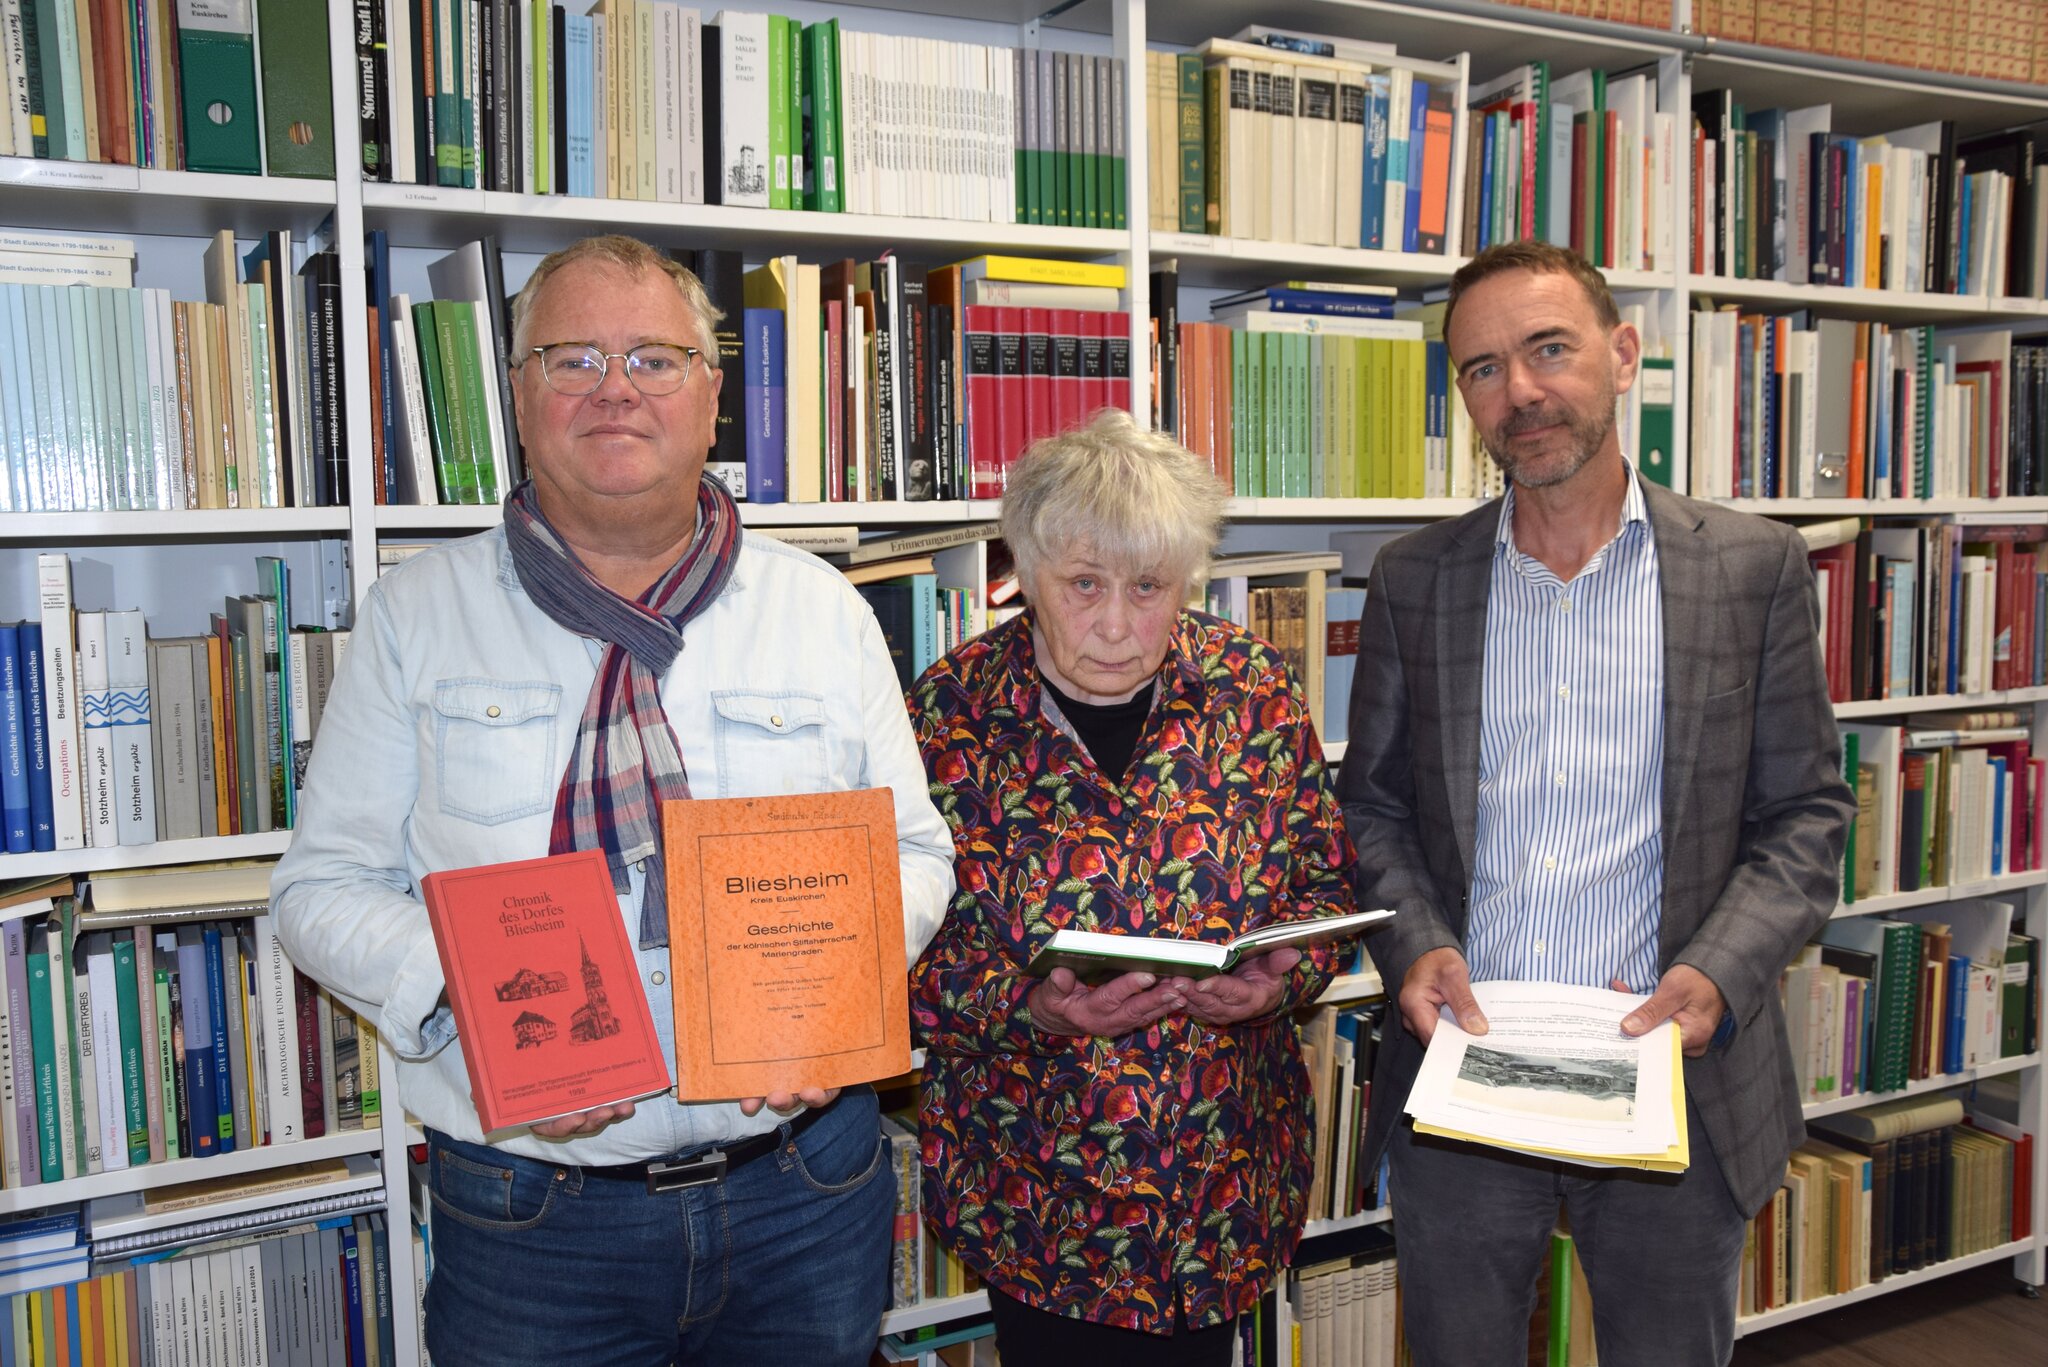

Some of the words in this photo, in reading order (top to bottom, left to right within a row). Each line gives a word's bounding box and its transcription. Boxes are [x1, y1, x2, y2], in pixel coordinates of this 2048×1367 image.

[357, 8, 373, 46] Stadt
[359, 57, 377, 120] Stommel
[498, 112, 508, 144] Erftstadt
[499, 144, 509, 186] Kulturhaus
[23, 240, 60, 249] Euskirchen
[18, 265, 55, 274] Euskirchen
[310, 311, 321, 368] EUSKIRCHEN
[324, 298, 337, 358] EUSKIRCHEN
[444, 327, 457, 365] Gemeinden
[462, 327, 474, 365] Gemeinden
[761, 325, 770, 366] Euskirchen
[762, 366, 770, 386] Kreis
[167, 385, 176, 403] 2024
[763, 386, 770, 397] im
[168, 403, 178, 439] Euskirchen
[763, 398, 771, 438] Geschichte
[453, 408, 467, 461] Sprachverhalten
[170, 439, 178, 456] Kreis
[172, 456, 182, 493] JAHRBUCH
[762, 478, 773, 487] 26
[834, 537, 848, 545] Köln
[889, 534, 952, 553] Erinnerungen
[952, 532, 964, 542] an
[964, 529, 980, 540] das
[979, 524, 998, 538] alte
[267, 616, 277, 638] BILD
[269, 640, 278, 653] IM
[28, 649, 40, 693] Euskirchen
[292, 639, 303, 685] BERGHEIM
[315, 643, 327, 689] BERGHEIM
[4, 655, 16, 700] Euskirchen
[53, 647, 66, 720] Besatzungszeiten
[30, 694, 41, 716] Kreis
[269, 671, 281, 730] EUSKIRCHEN
[295, 685, 305, 710] KREIS
[7, 700, 17, 722] Kreis
[33, 715, 42, 728] im
[9, 721, 18, 734] im
[10, 734, 21, 777] Geschichte
[35, 727, 46, 770] Geschichte
[272, 731, 282, 757] KREIS
[58, 739, 72, 798] Occupations
[96, 744, 107, 776] erzählt
[130, 742, 142, 773] erzählt
[98, 777, 109, 825] Stotzheim
[131, 774, 143, 822] Stotzheim
[14, 829, 25, 839] 35
[38, 823, 50, 832] 36
[725, 871, 849, 894] Bliesheim
[502, 891, 553, 909] Chronik
[750, 896, 774, 904] Kreis
[776, 893, 826, 903] Euskirchen
[498, 911, 520, 925] des
[522, 905, 565, 921] Dorfes
[504, 918, 566, 938] Bliesheim
[747, 920, 834, 936] Geschichte
[726, 943, 742, 951] der
[743, 940, 792, 950] kölnischen
[792, 934, 858, 947] Stiftsherrschaft
[270, 934, 285, 1016] FUNDE/BERGHEIM
[80, 991, 91, 1038] ERFTKREIS
[82, 1038, 92, 1057] DER
[161, 1039, 170, 1056] KÖLN
[216, 1030, 226, 1054] ERFT
[127, 1047, 138, 1078] Erftkreis
[162, 1055, 171, 1067] UM
[218, 1057, 227, 1074] DIE
[276, 1016, 291, 1098] ARCHÄOLOGISCHE
[41, 1063, 52, 1095] Erftkreis
[129, 1079, 138, 1090] im
[163, 1066, 172, 1083] RUND
[306, 1065, 315, 1083] 700
[44, 1095, 52, 1106] im
[62, 1084, 73, 1119] WOHNEN
[129, 1090, 140, 1108] Stifte
[44, 1106, 55, 1125] Stifte
[132, 1108, 141, 1123] und
[47, 1124, 55, 1134] und
[284, 1124, 294, 1137] 2
[47, 1134, 58, 1166] Klöster
[163, 1200, 187, 1210] Chronik
[243, 1179, 304, 1197] Schützenbruderschaft
[248, 1265, 257, 1289] 10/2014
[250, 1288, 258, 1304] Band
[252, 1317, 262, 1367] Geschichtsvereins
